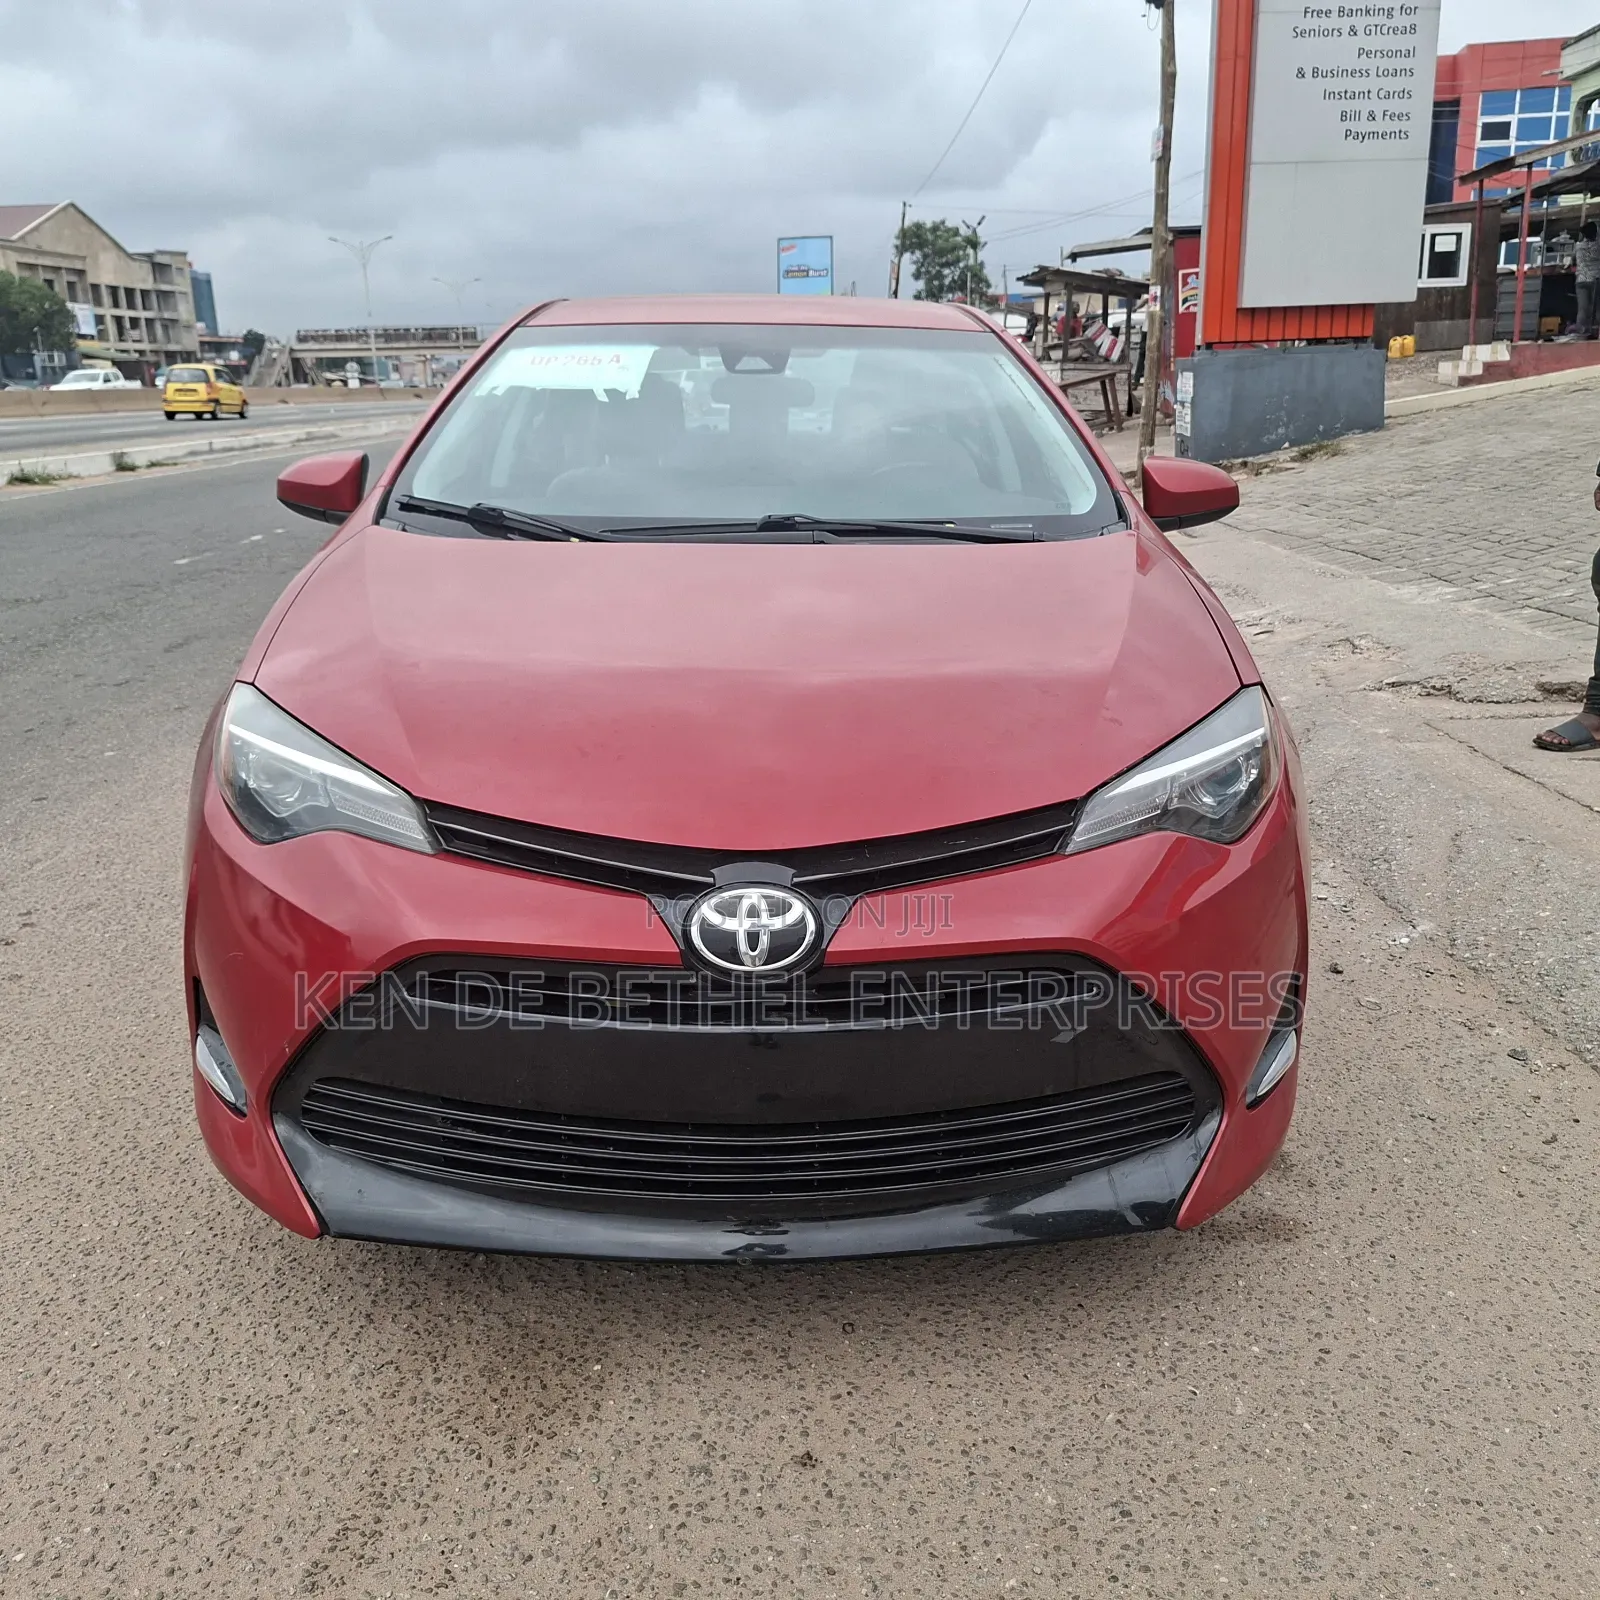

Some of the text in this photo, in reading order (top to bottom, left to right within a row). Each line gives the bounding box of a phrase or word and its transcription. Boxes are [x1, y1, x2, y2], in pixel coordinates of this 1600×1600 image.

[1303, 3, 1419, 19] Free Banking for
[1292, 23, 1417, 39] Seniors & GTCrea8
[1357, 46, 1416, 59] Personal
[1295, 65, 1415, 79] & Business Loans
[1323, 87, 1413, 101] Instant Cards
[1340, 110, 1411, 123] Bill & Fees
[1344, 128, 1410, 144] Payments
